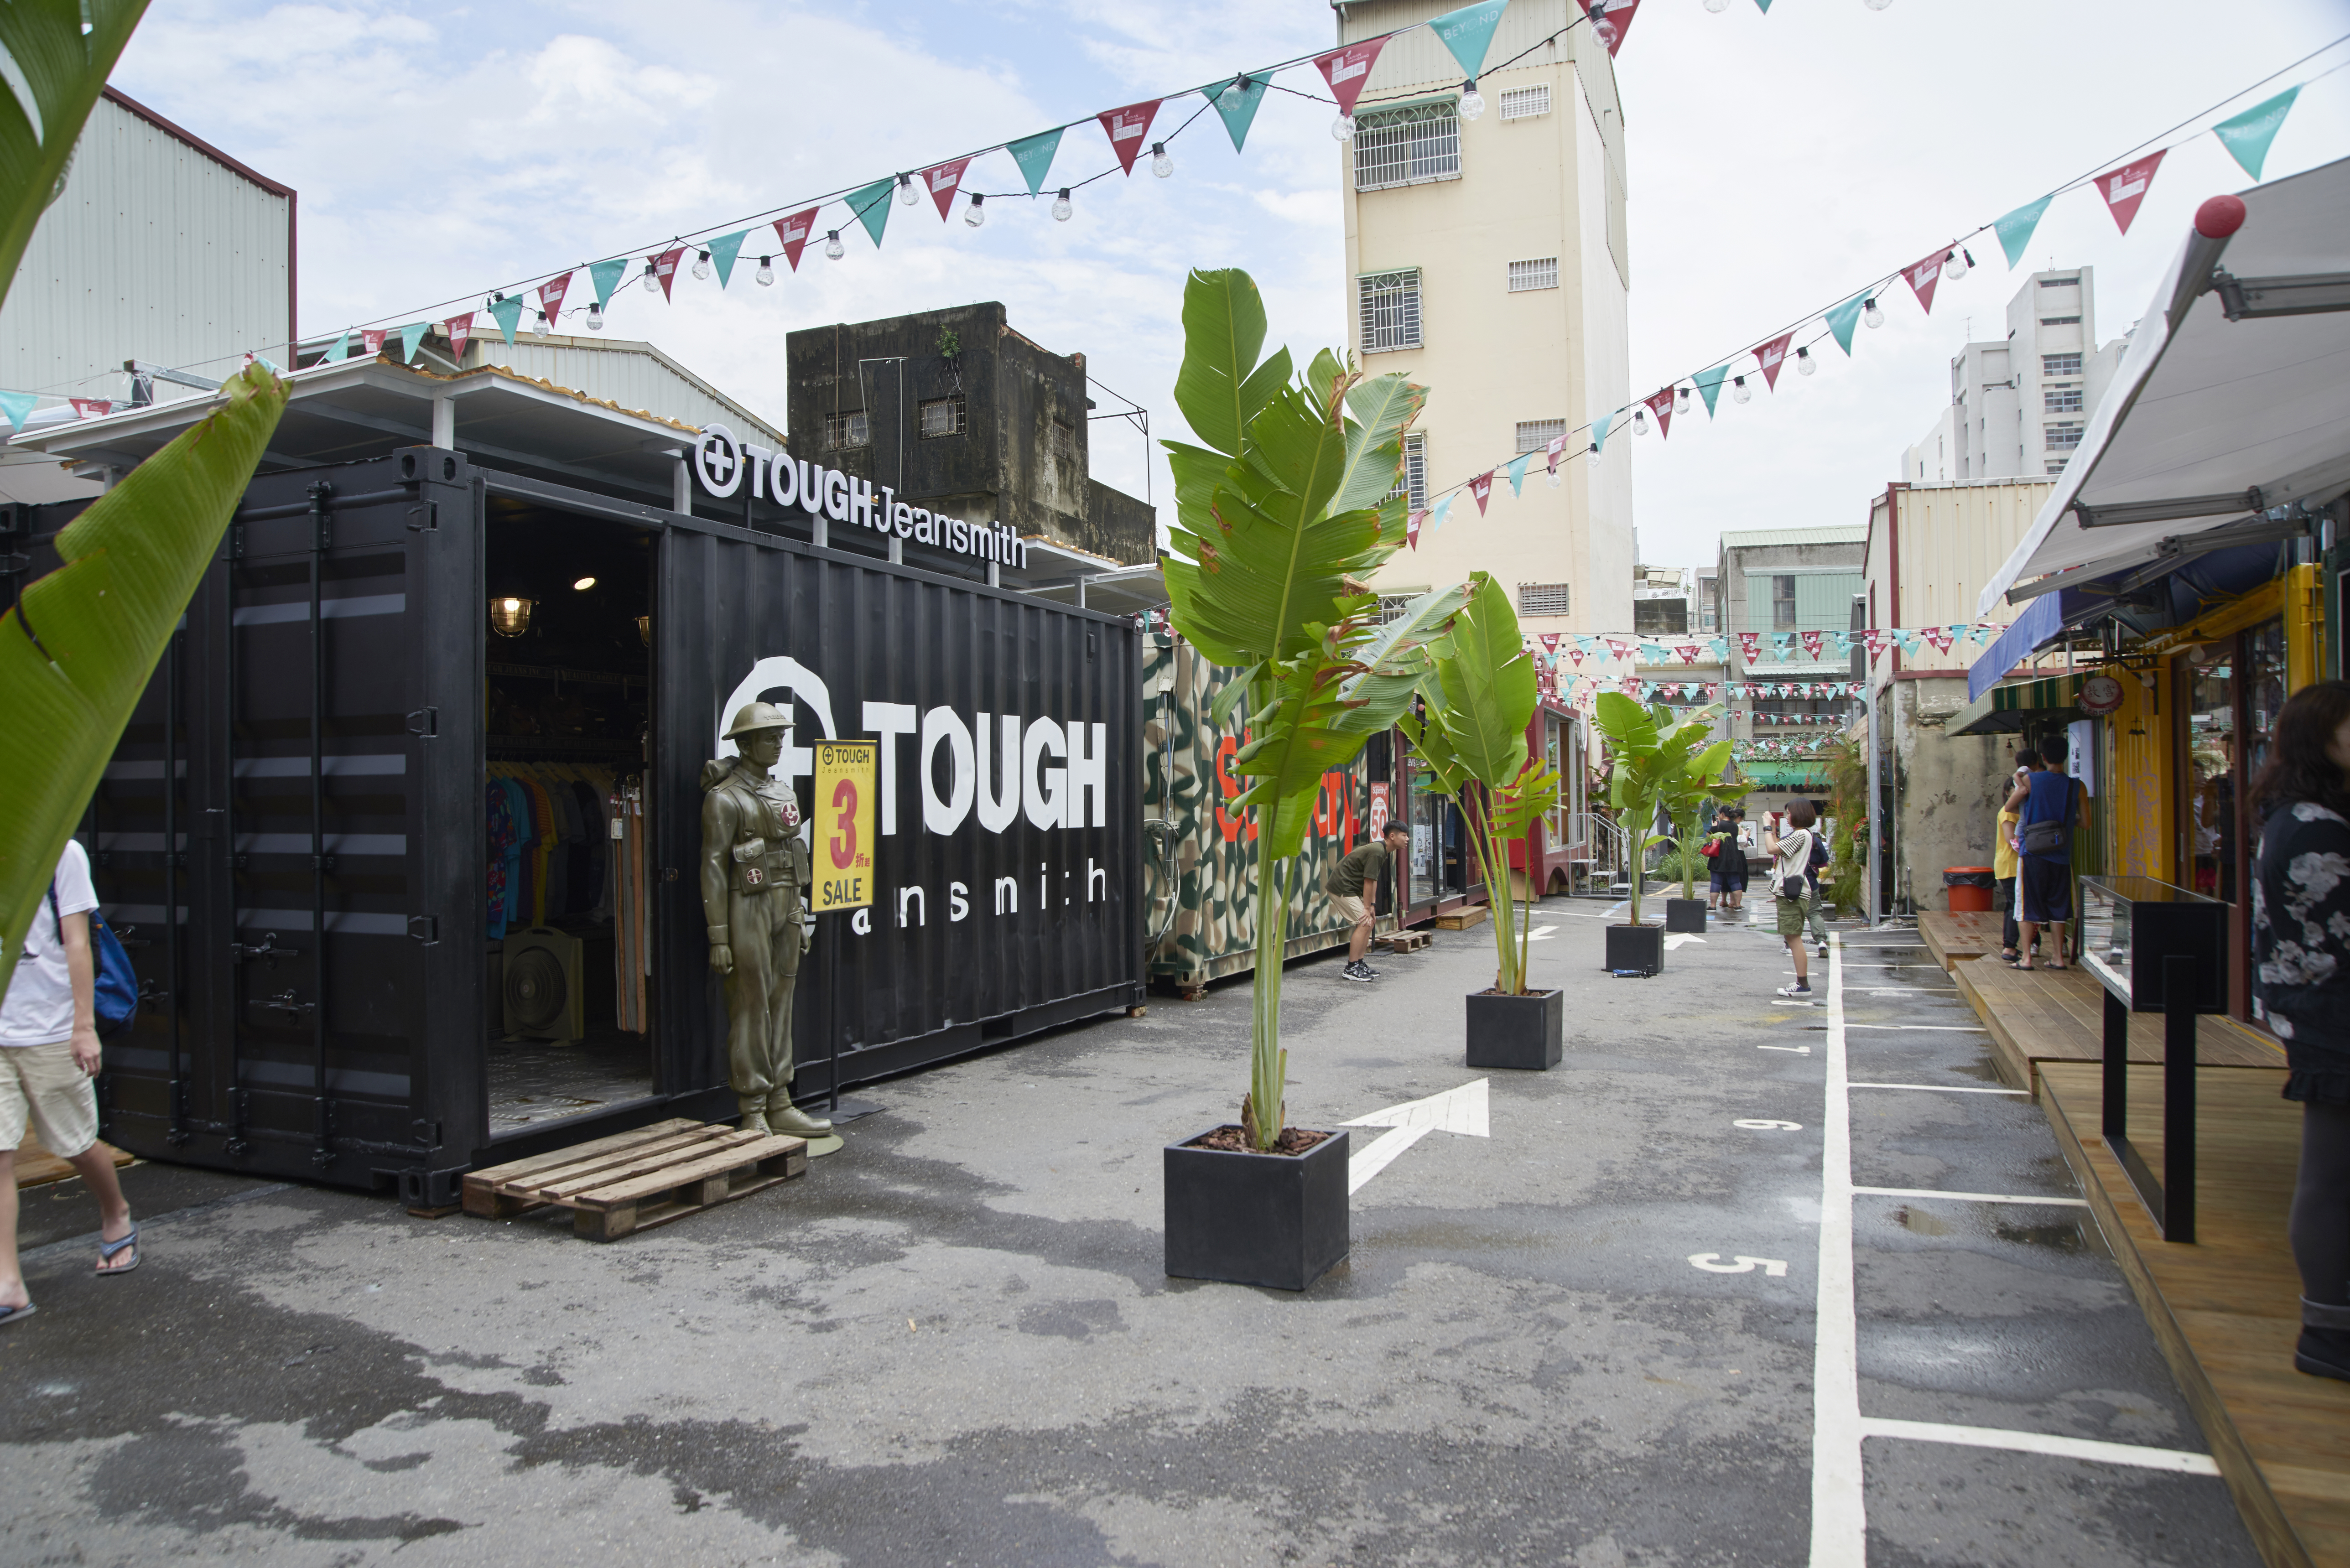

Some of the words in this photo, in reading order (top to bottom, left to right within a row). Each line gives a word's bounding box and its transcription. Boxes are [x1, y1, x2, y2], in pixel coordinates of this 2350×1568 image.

[1444, 10, 1498, 40] BEYOND
[1347, 54, 1369, 64] ZHENGXING
[1217, 88, 1262, 110] BND
[1018, 141, 1055, 163] BEYOND
[712, 241, 740, 256] BEYOND
[1830, 303, 1861, 327] BEYND
[403, 332, 422, 341] BEYND
[330, 343, 347, 362] BEYND
[744, 441, 872, 528] TOUGH
[875, 485, 1027, 569] Jeansmith
[835, 748, 869, 763] TOUGH
[863, 701, 1106, 836] TOUGH
[830, 778, 858, 870] 3
[1371, 809, 1387, 839] 50
[822, 877, 862, 906] SALE
[1757, 1045, 1811, 1056] 7
[1687, 1252, 1788, 1277] 5
